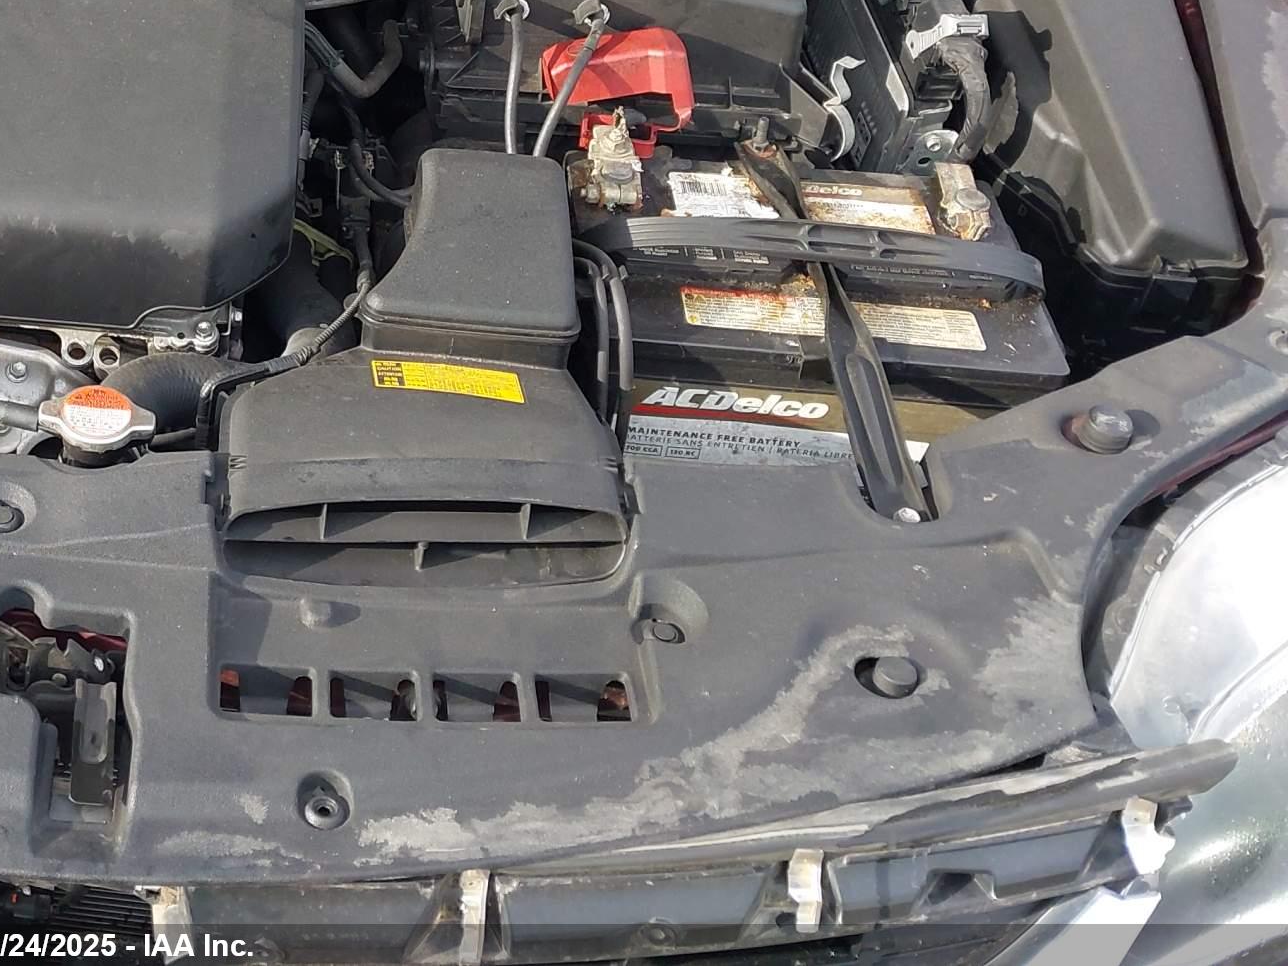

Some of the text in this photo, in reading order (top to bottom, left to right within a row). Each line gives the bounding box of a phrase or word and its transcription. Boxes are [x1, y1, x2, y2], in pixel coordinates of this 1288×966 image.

[803, 184, 863, 197] Delco
[641, 386, 831, 420] ACDelco
[627, 426, 802, 449] MAINTENANCE FREE BATTERY
[676, 438, 704, 448] SANS
[707, 440, 765, 453] ENTRETIEN
